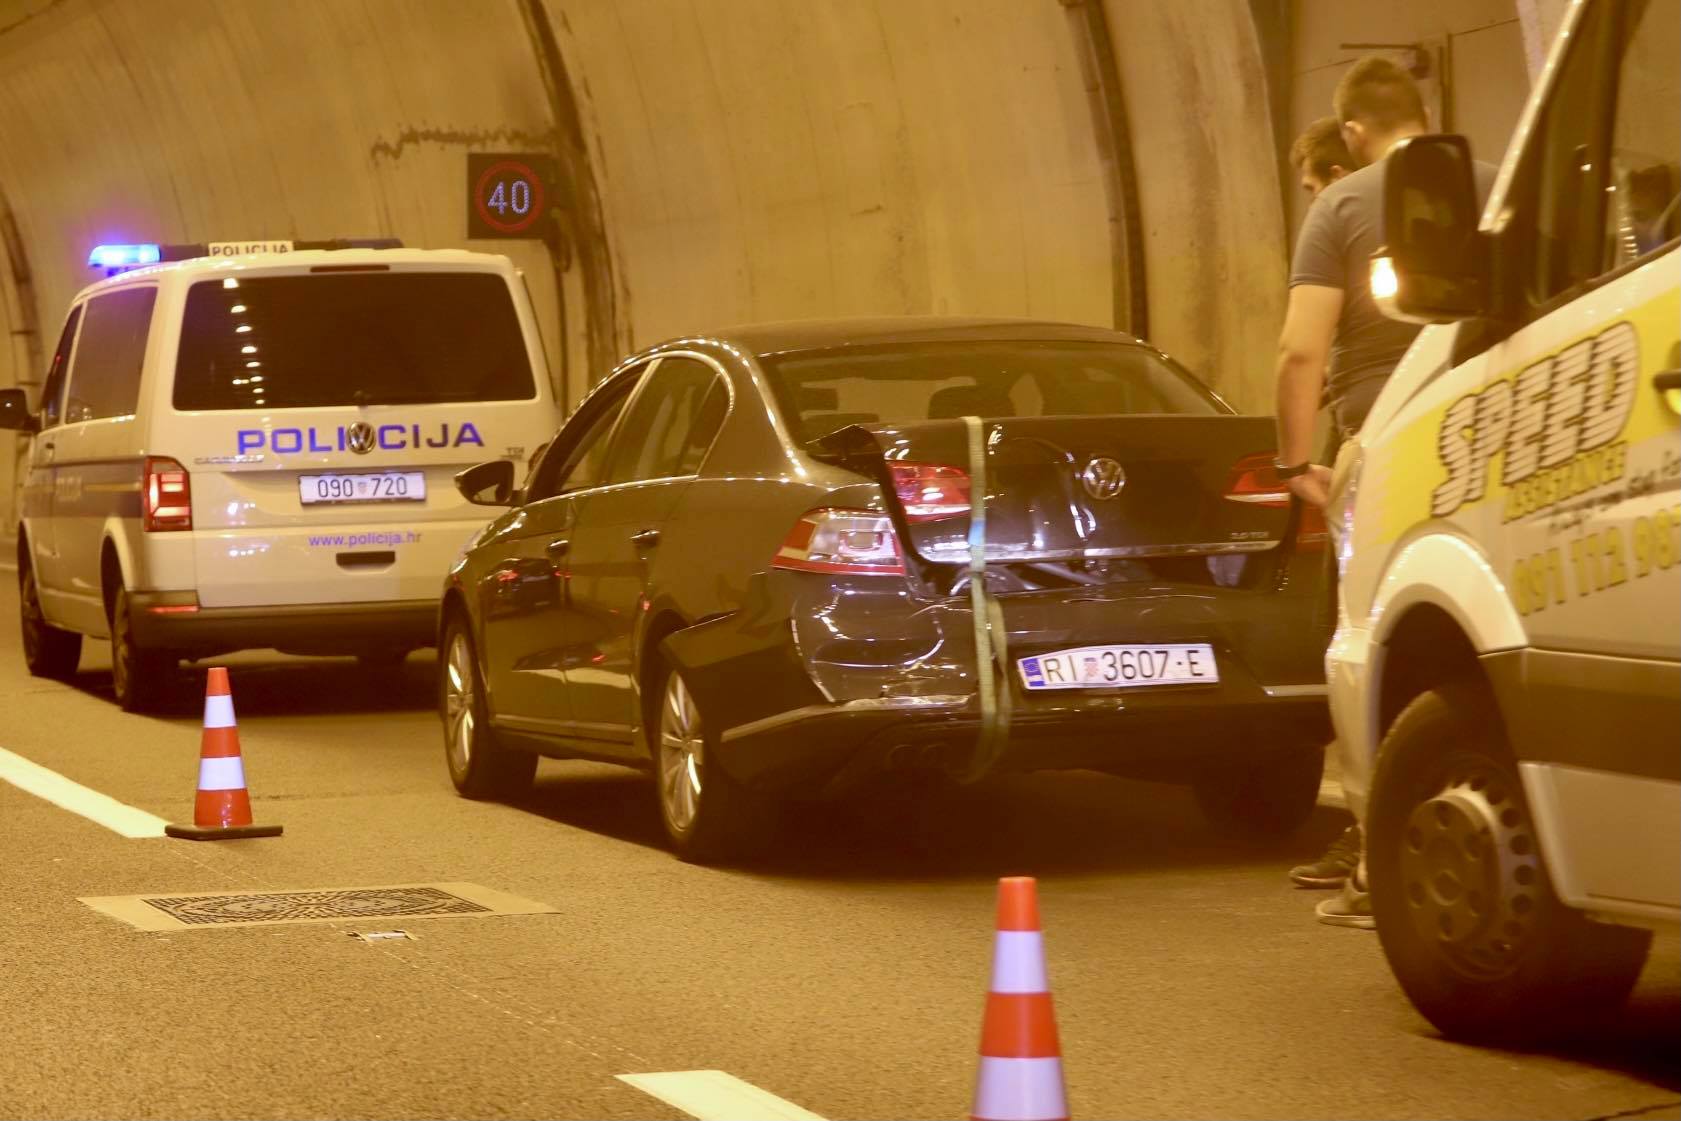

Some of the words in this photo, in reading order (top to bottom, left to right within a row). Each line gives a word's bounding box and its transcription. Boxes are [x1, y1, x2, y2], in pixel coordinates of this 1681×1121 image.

[488, 181, 529, 214] 40
[1430, 320, 1640, 518] SPEED
[237, 423, 484, 455] POLICIJA
[318, 479, 353, 498] 090
[371, 477, 407, 496] 720
[308, 530, 421, 547] www.policija.hr
[1043, 655, 1077, 683] RI
